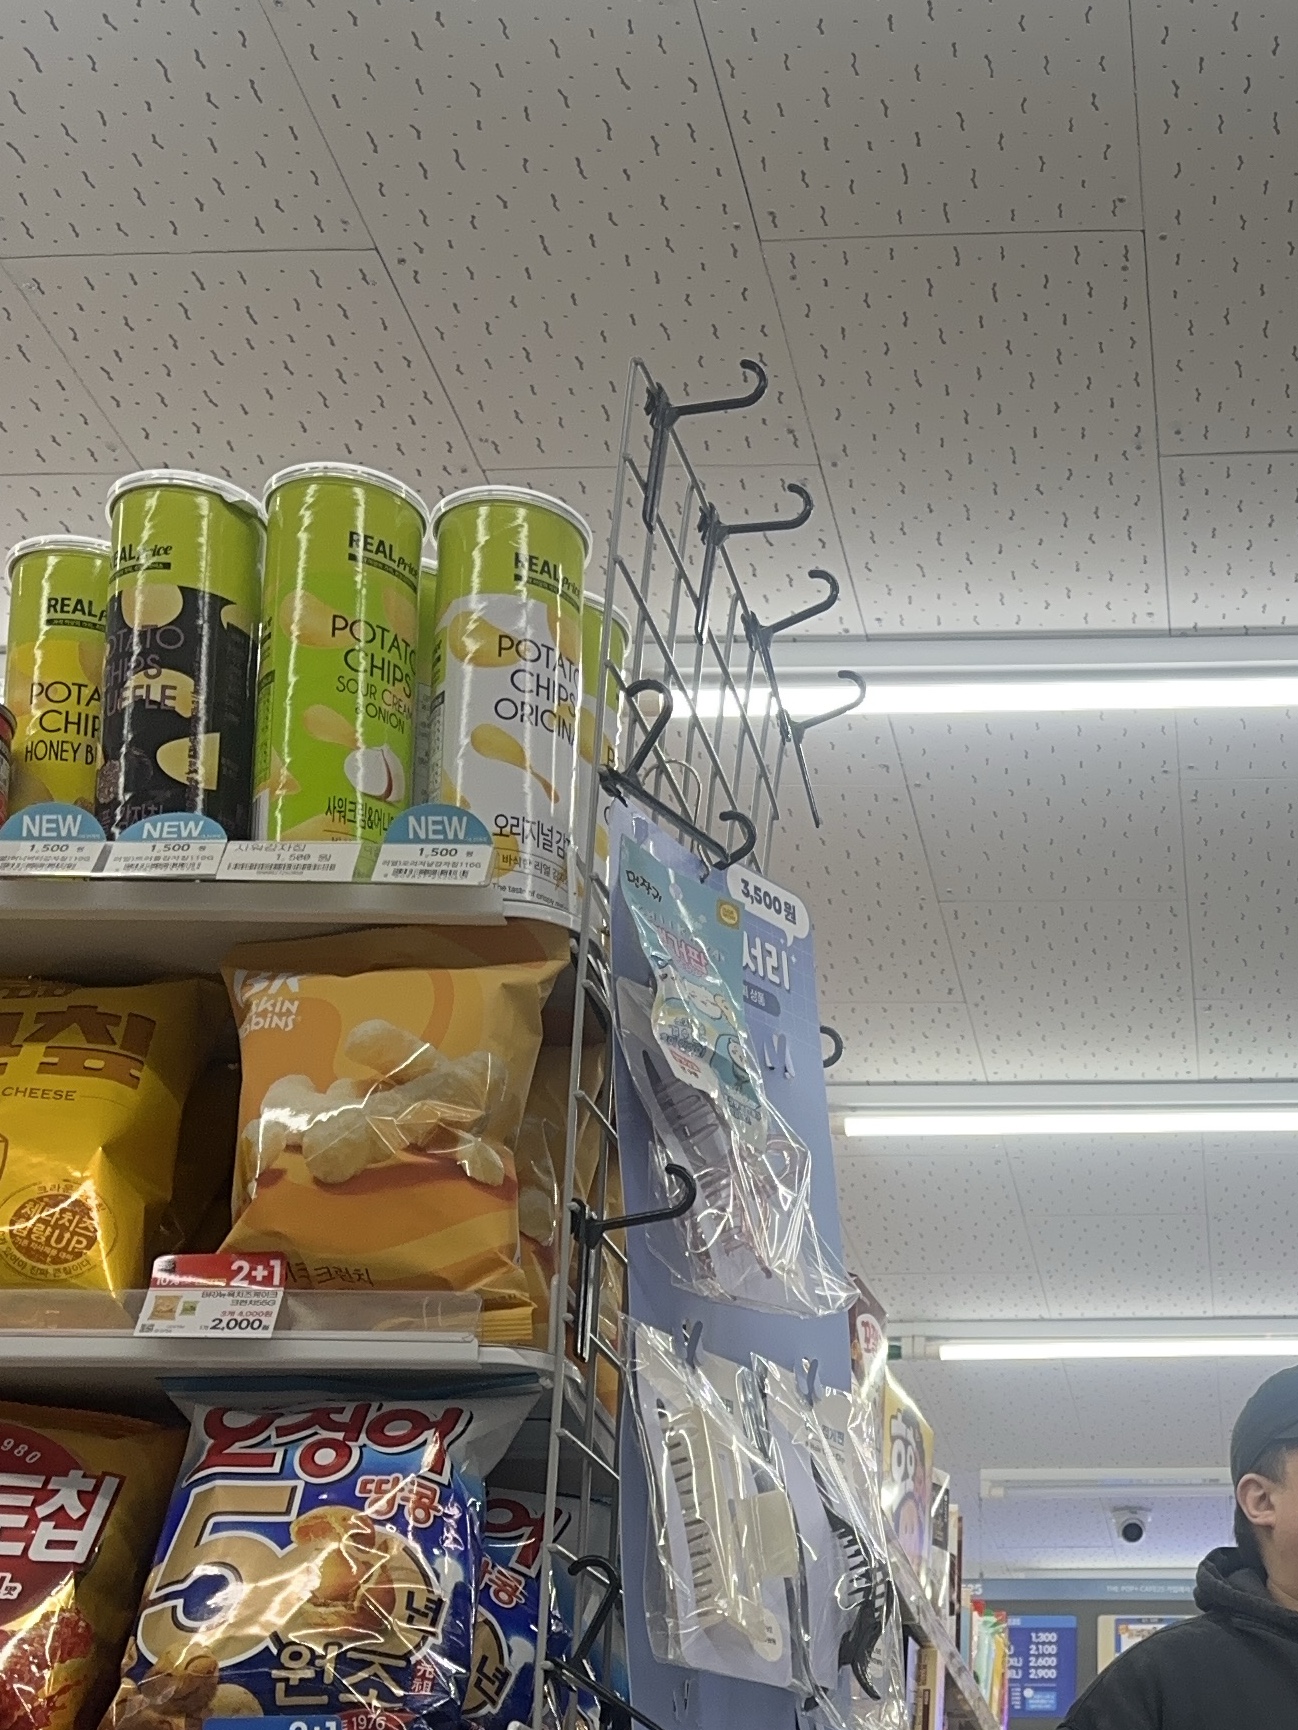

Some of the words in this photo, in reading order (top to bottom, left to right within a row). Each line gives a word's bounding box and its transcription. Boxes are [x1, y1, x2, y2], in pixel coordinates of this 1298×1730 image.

[349, 531, 397, 565] REAL
[514, 551, 560, 583] REAL
[47, 597, 98, 619] REAL
[107, 624, 185, 656] OTATO
[106, 653, 162, 687] HIPS
[344, 649, 412, 698] CHIPS
[30, 680, 101, 704] POTA
[106, 684, 178, 717] UFFLE
[336, 675, 378, 701] SOUR
[39, 710, 101, 737] CHIP
[365, 703, 405, 735] ONION
[25, 739, 81, 763] HONEY
[22, 815, 82, 838] NEW
[142, 821, 204, 840] NEW
[408, 815, 468, 841] NEW
[494, 813, 555, 851] 오리지널
[29, 843, 69, 853] 1,500
[151, 843, 190, 853] 1,500
[418, 847, 458, 859] 1,500
[2, 1086, 77, 1101] CHEESE
[230, 1259, 281, 1286] 2+1
[210, 1318, 262, 1331] 2,000
[0, 1438, 42, 1464] 980
[190, 1403, 464, 1484] 오징어
[356, 1474, 444, 1528] 땅콩
[270, 1641, 411, 1709] 원조
